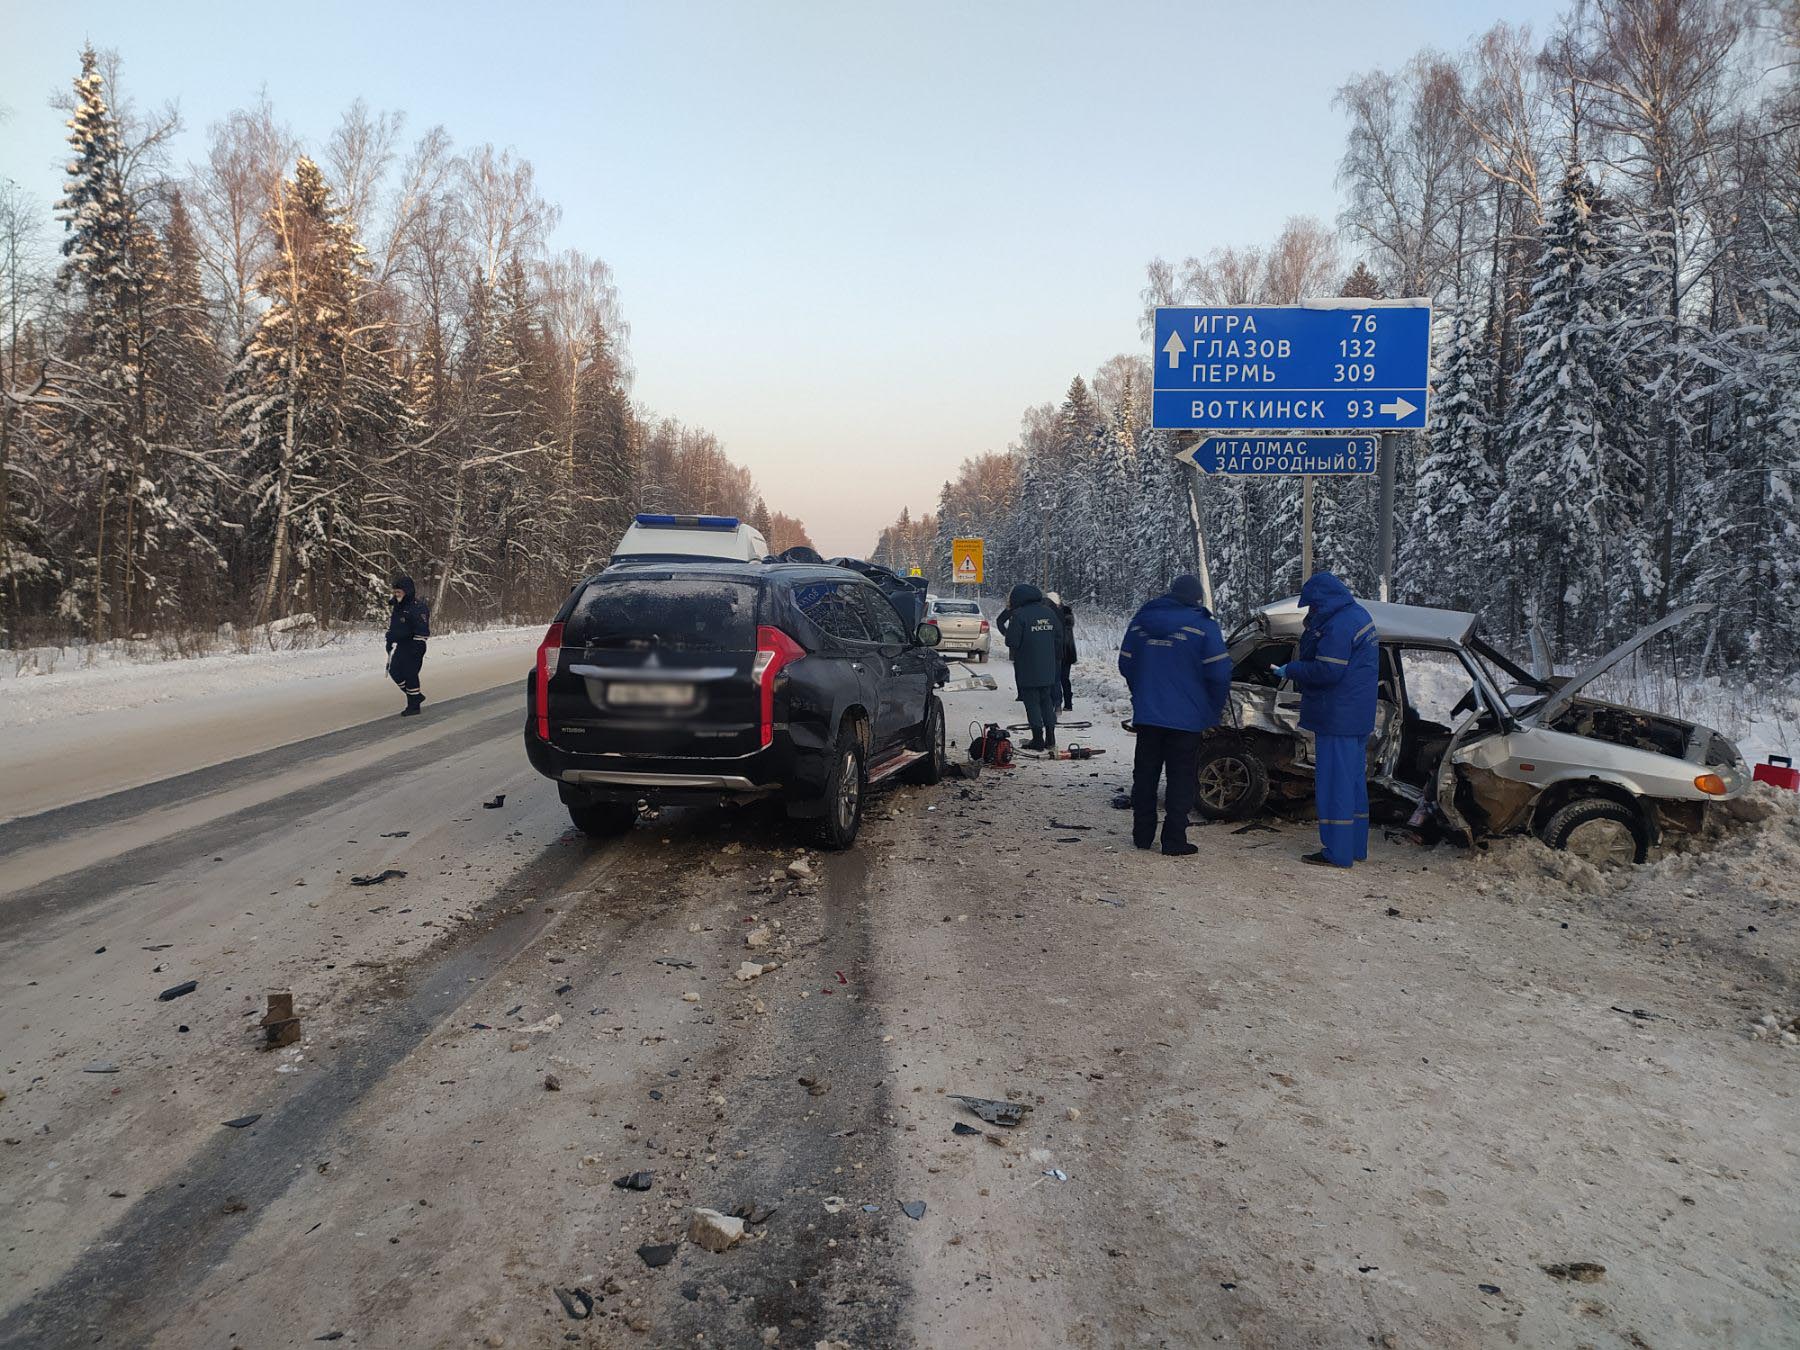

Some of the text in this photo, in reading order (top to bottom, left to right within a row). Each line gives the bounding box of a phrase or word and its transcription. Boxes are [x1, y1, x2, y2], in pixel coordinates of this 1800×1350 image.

[1193, 314, 1377, 334] ИГРА 76
[1193, 339, 1376, 358] ГЛАЗОВ 132
[1192, 363, 1375, 383] ПЕРМЬ 309
[1191, 399, 1374, 419] ВОТКИНСК 93
[1215, 441, 1307, 455] ИТАЛМАС
[1215, 453, 1373, 472] ЗАГОРОДНЫЙ 0,7
